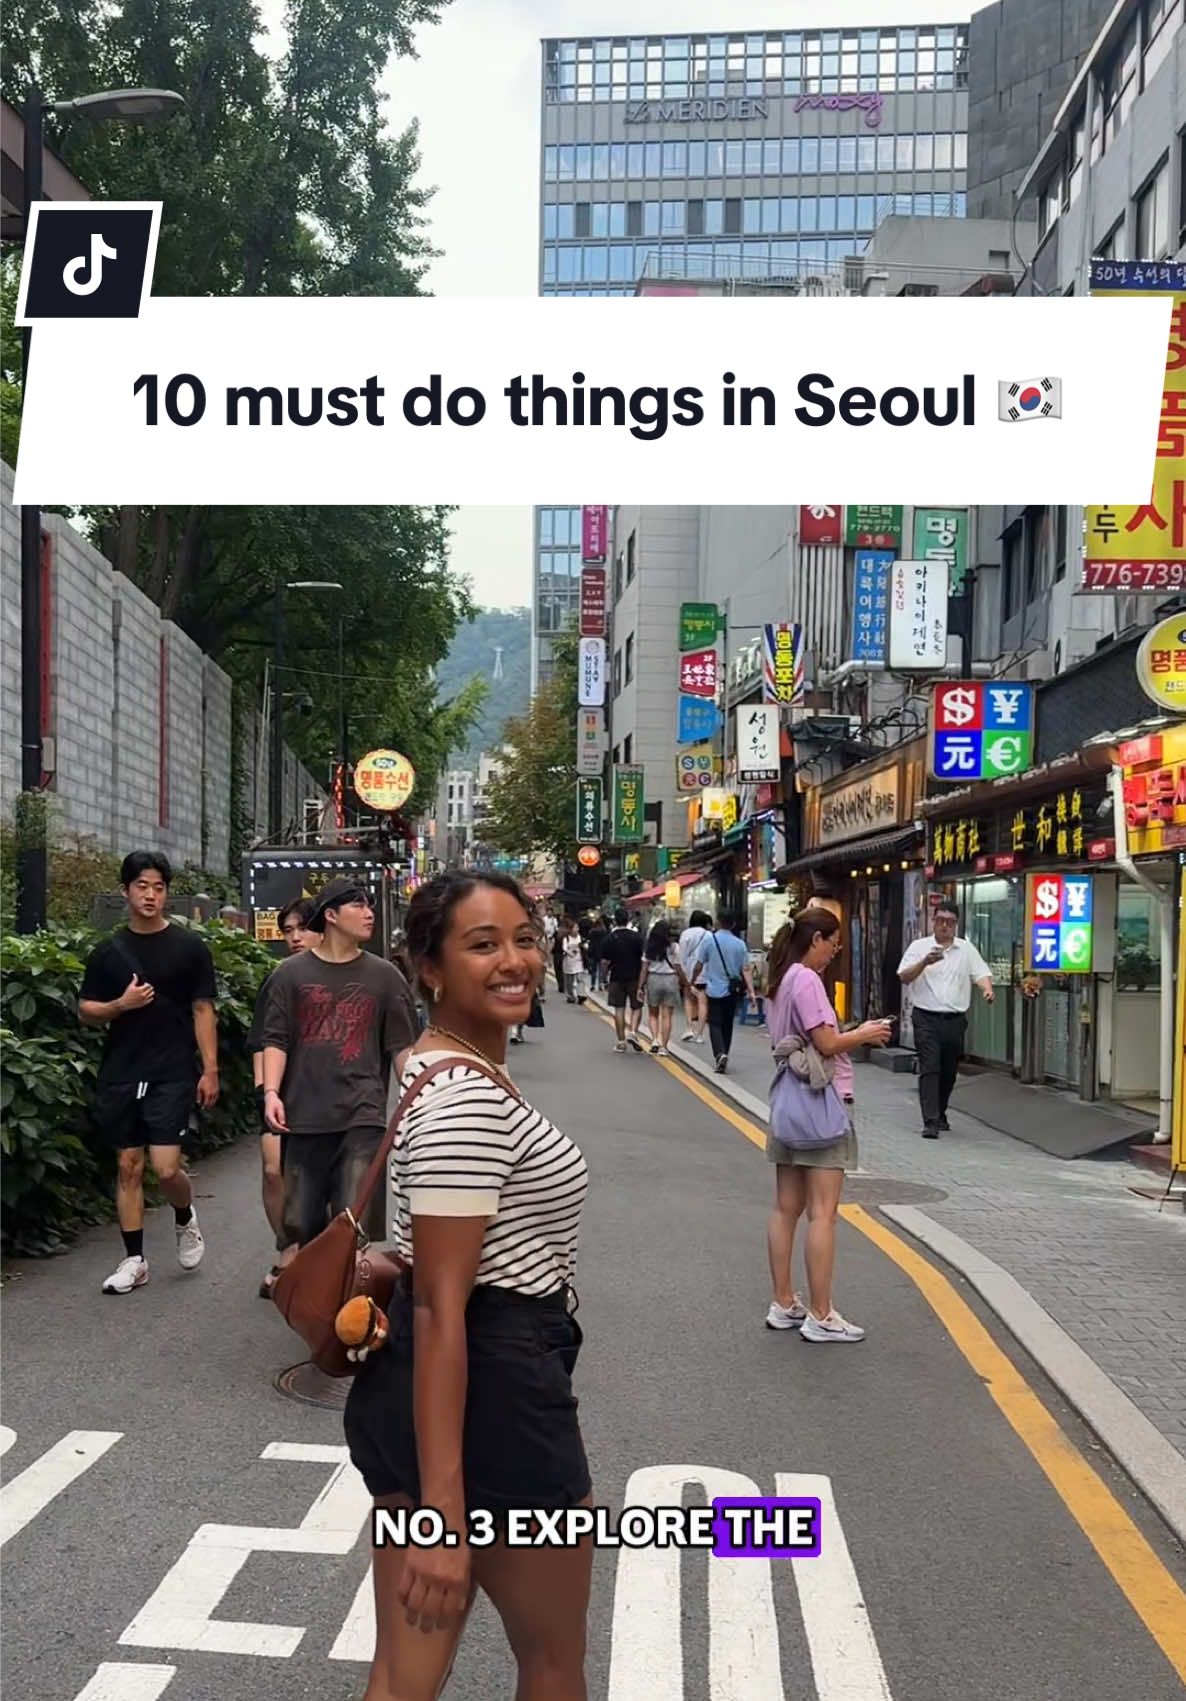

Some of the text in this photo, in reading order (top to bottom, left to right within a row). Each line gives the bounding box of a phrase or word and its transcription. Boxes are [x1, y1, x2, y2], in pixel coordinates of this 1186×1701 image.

[655, 98, 768, 122] MERIDIEN
[794, 93, 883, 128] moxy
[1092, 505, 1119, 544] 두
[1090, 563, 1186, 585] 776-739
[943, 736, 975, 771] 元
[1034, 928, 1057, 963] 元
